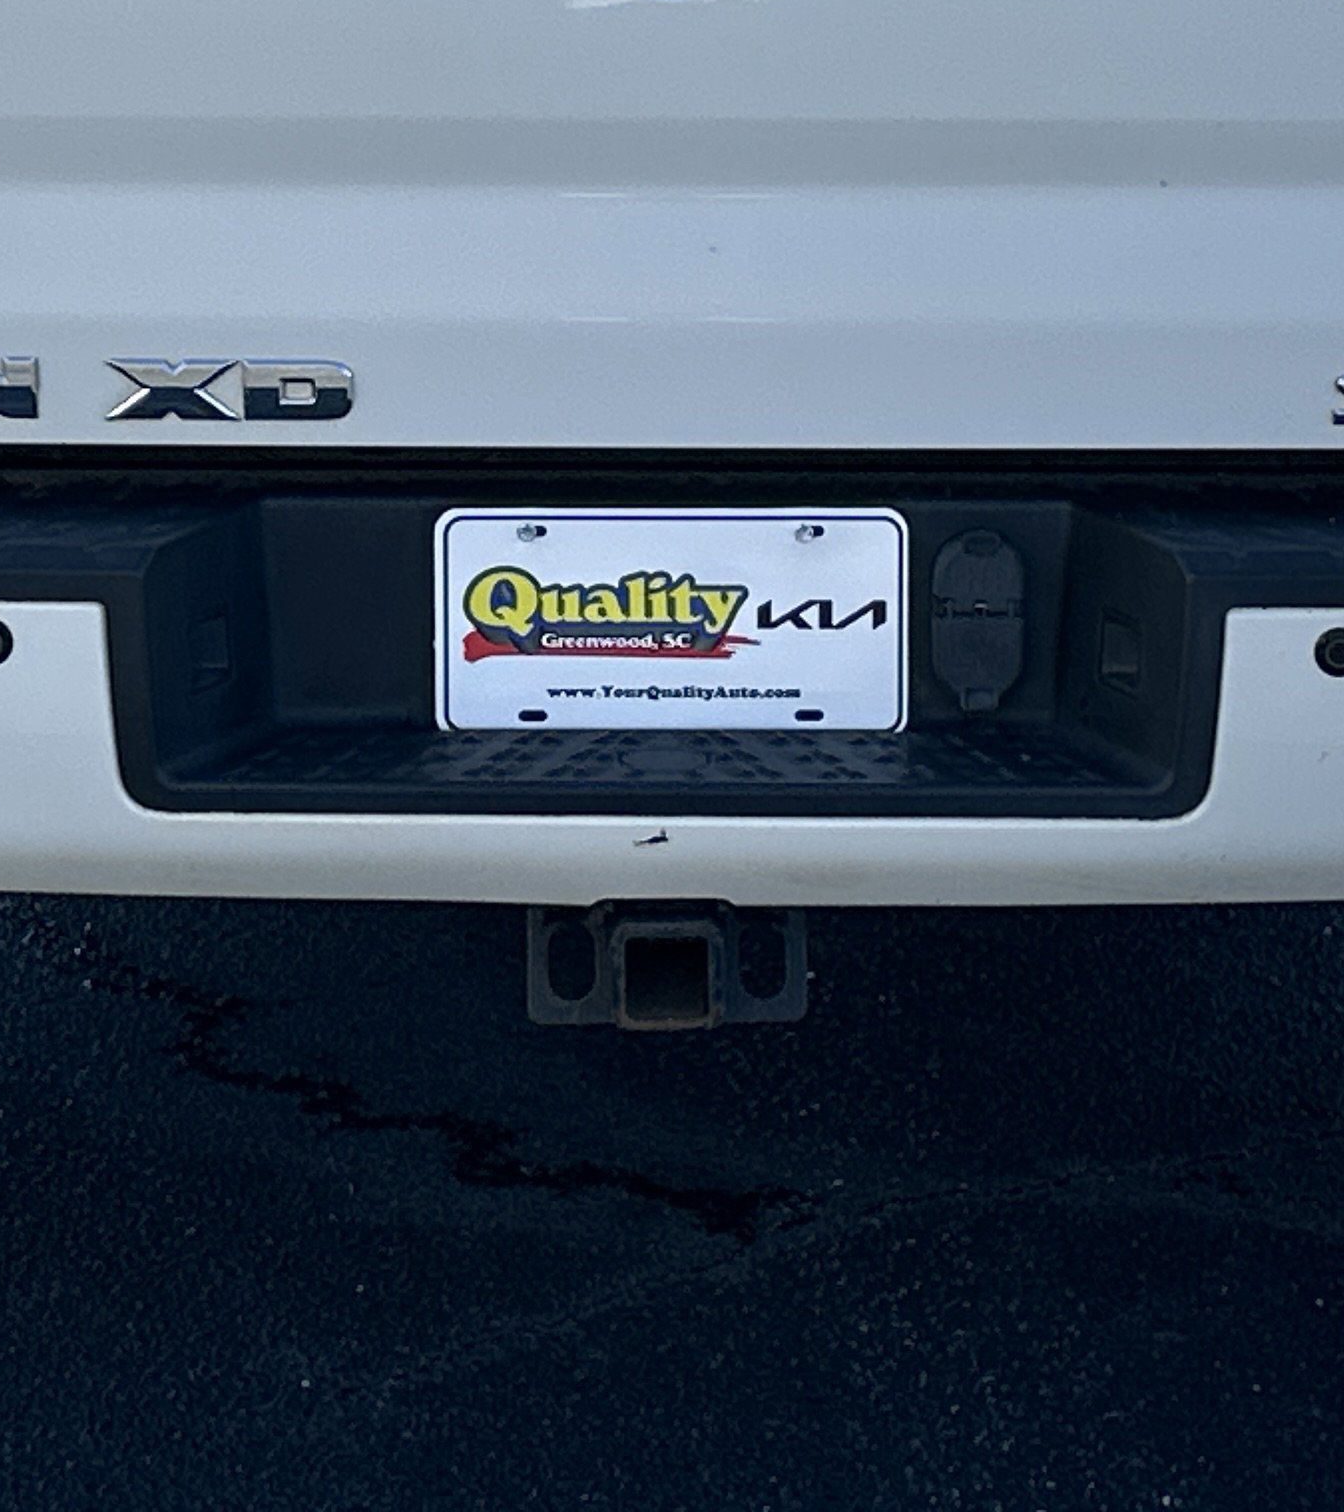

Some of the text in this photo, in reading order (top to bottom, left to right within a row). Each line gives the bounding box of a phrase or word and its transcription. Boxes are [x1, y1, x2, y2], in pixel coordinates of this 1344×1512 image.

[103, 356, 356, 421] XD
[467, 568, 746, 636] Quality
[757, 599, 887, 631] KIA
[540, 632, 693, 651] Greenwood, SC
[547, 685, 802, 701] www.YourQualityAuto.com
